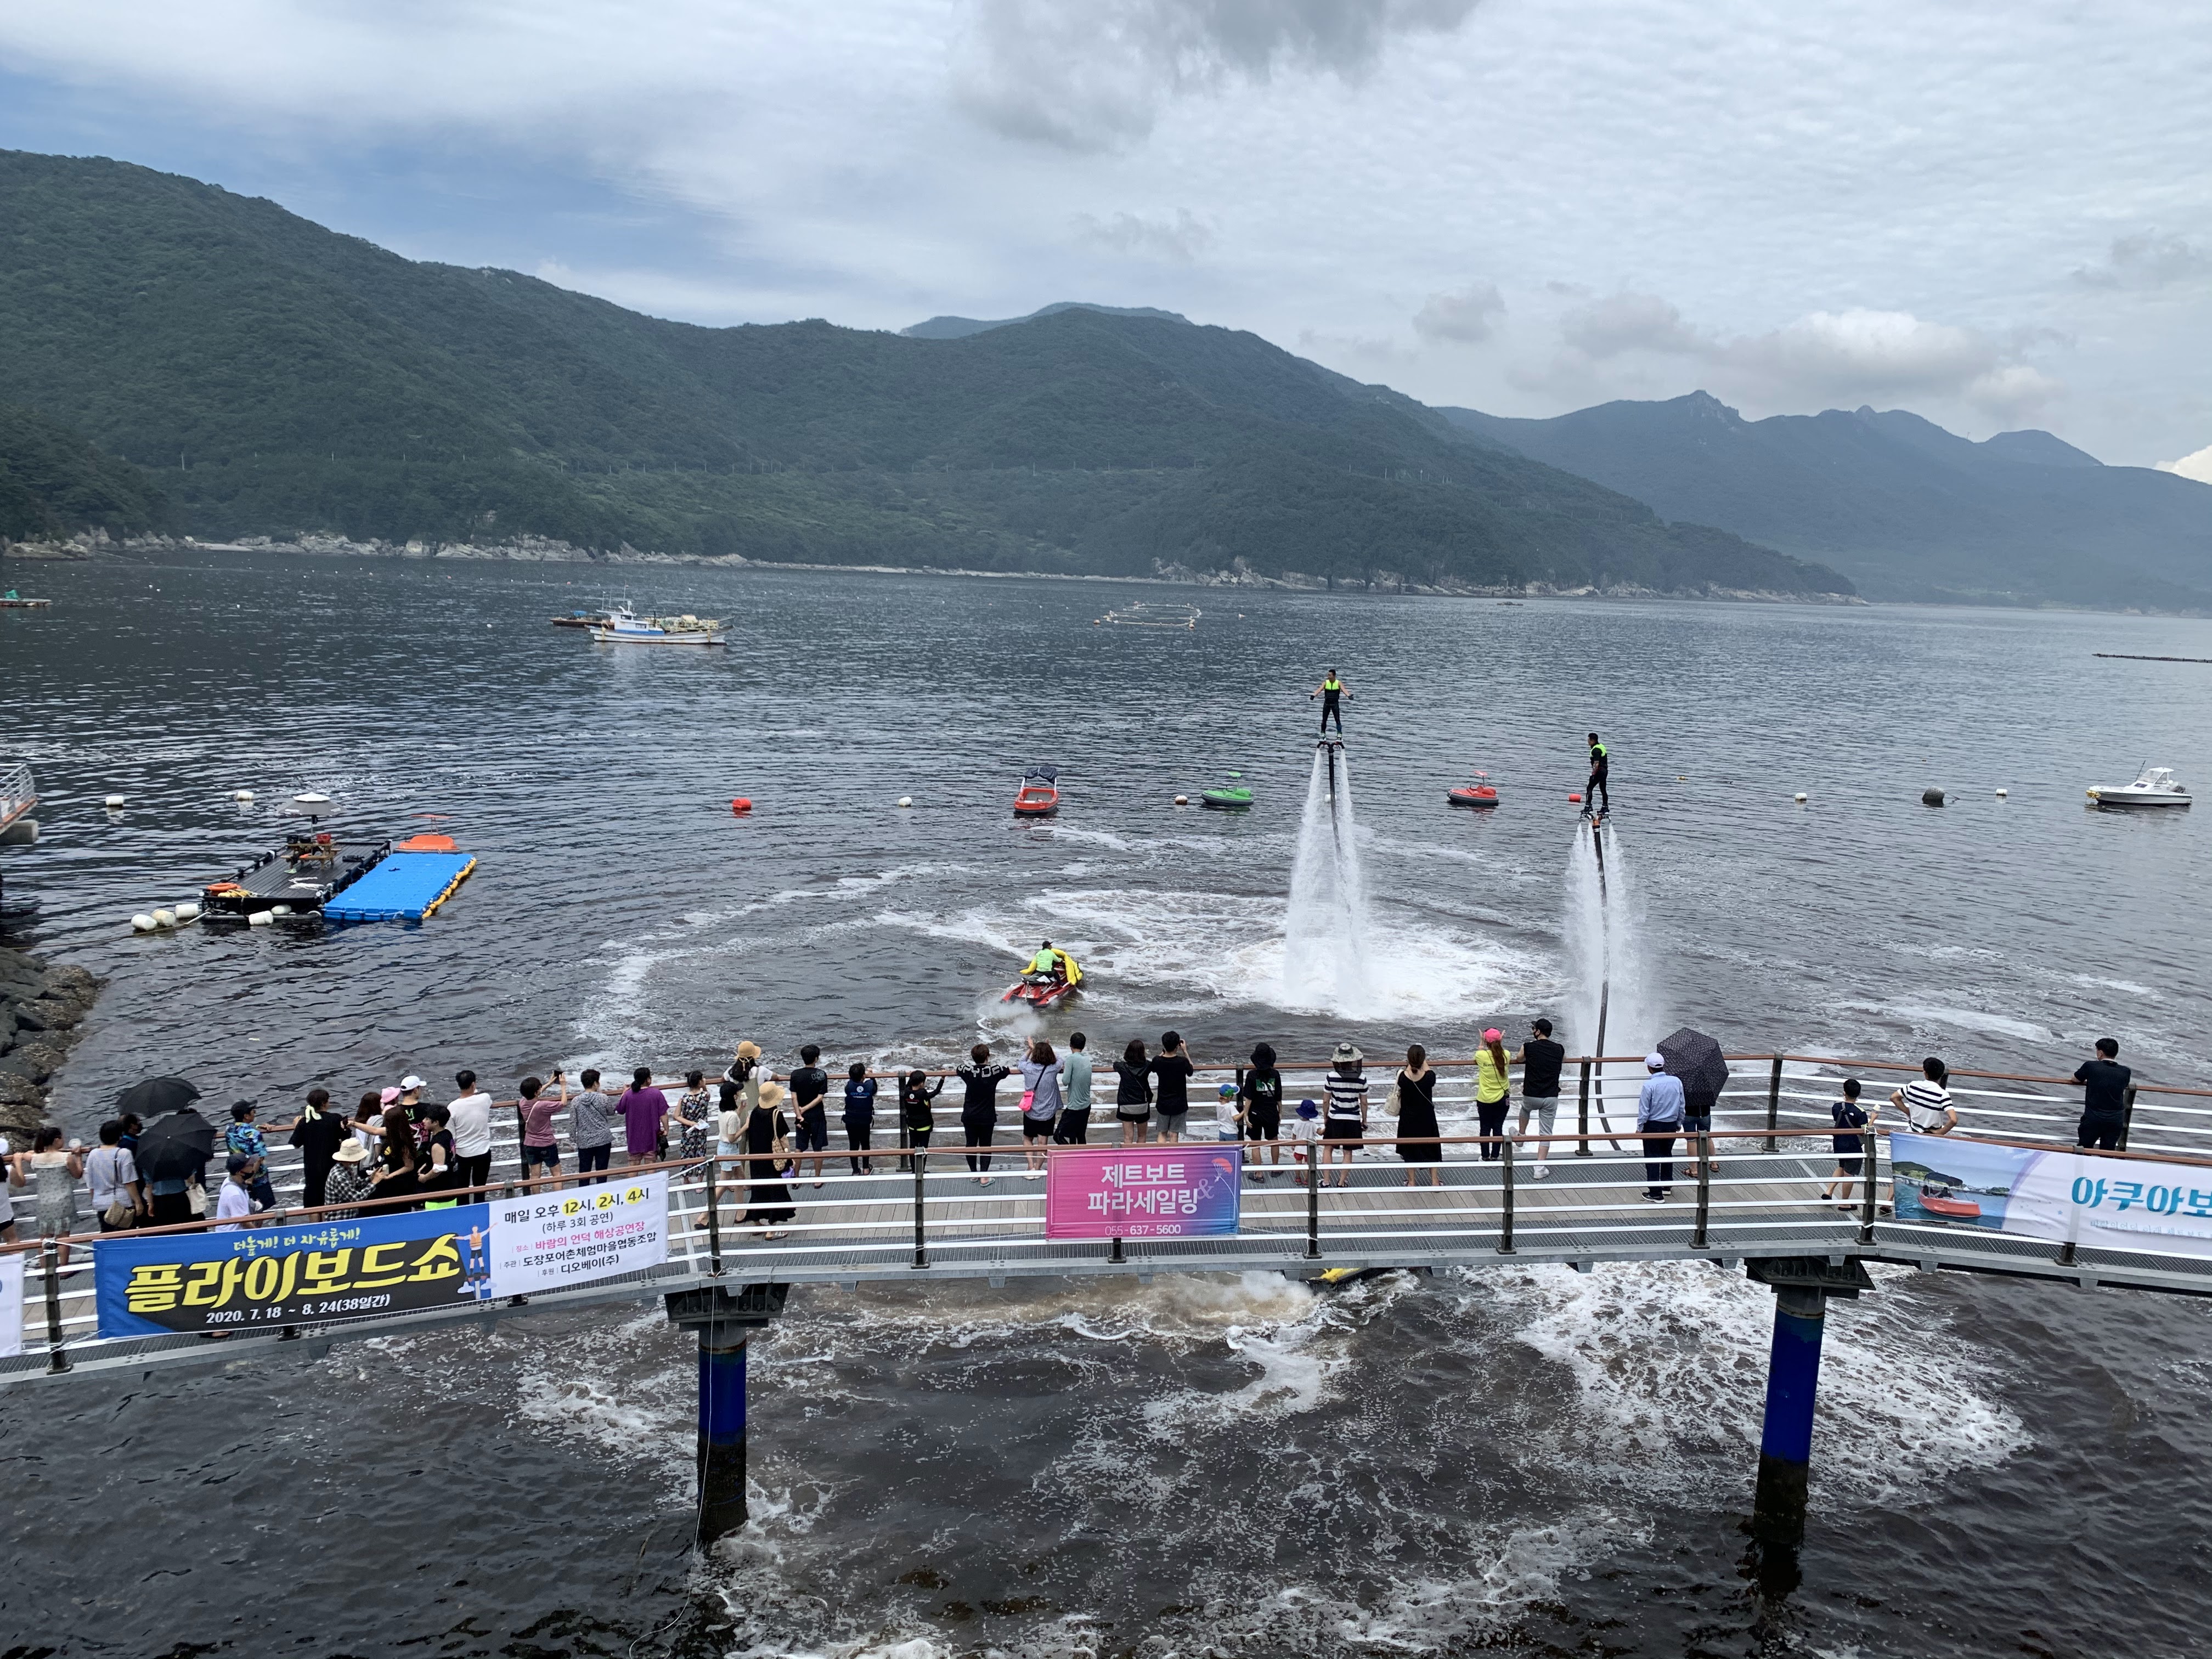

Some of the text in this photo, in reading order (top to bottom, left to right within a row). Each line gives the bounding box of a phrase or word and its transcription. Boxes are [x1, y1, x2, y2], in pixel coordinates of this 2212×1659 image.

[1101, 1164, 1187, 1189] 제트보트
[505, 1188, 649, 1223] 매일 오후 12시, 2시, 4시
[1088, 1188, 1198, 1215] 파라세일링
[535, 1236, 567, 1250] 바람의
[571, 1232, 591, 1245] 언덕
[594, 1221, 645, 1240] 해상공연장
[542, 1211, 613, 1234] (하루 3회 공연)
[284, 1236, 296, 1246] 더
[300, 1227, 360, 1248] 자유롭게!
[523, 1231, 657, 1267] 도장포어촌체험마을협동조합
[125, 1234, 460, 1312] 플라이보드쇼
[561, 1254, 619, 1274] 디오베이(주)
[205, 1310, 245, 1324] 2020.
[250, 1309, 261, 1320] 7.
[266, 1307, 281, 1318] 18
[302, 1304, 314, 1315] 8.
[319, 1294, 390, 1314] 24(38일간)
